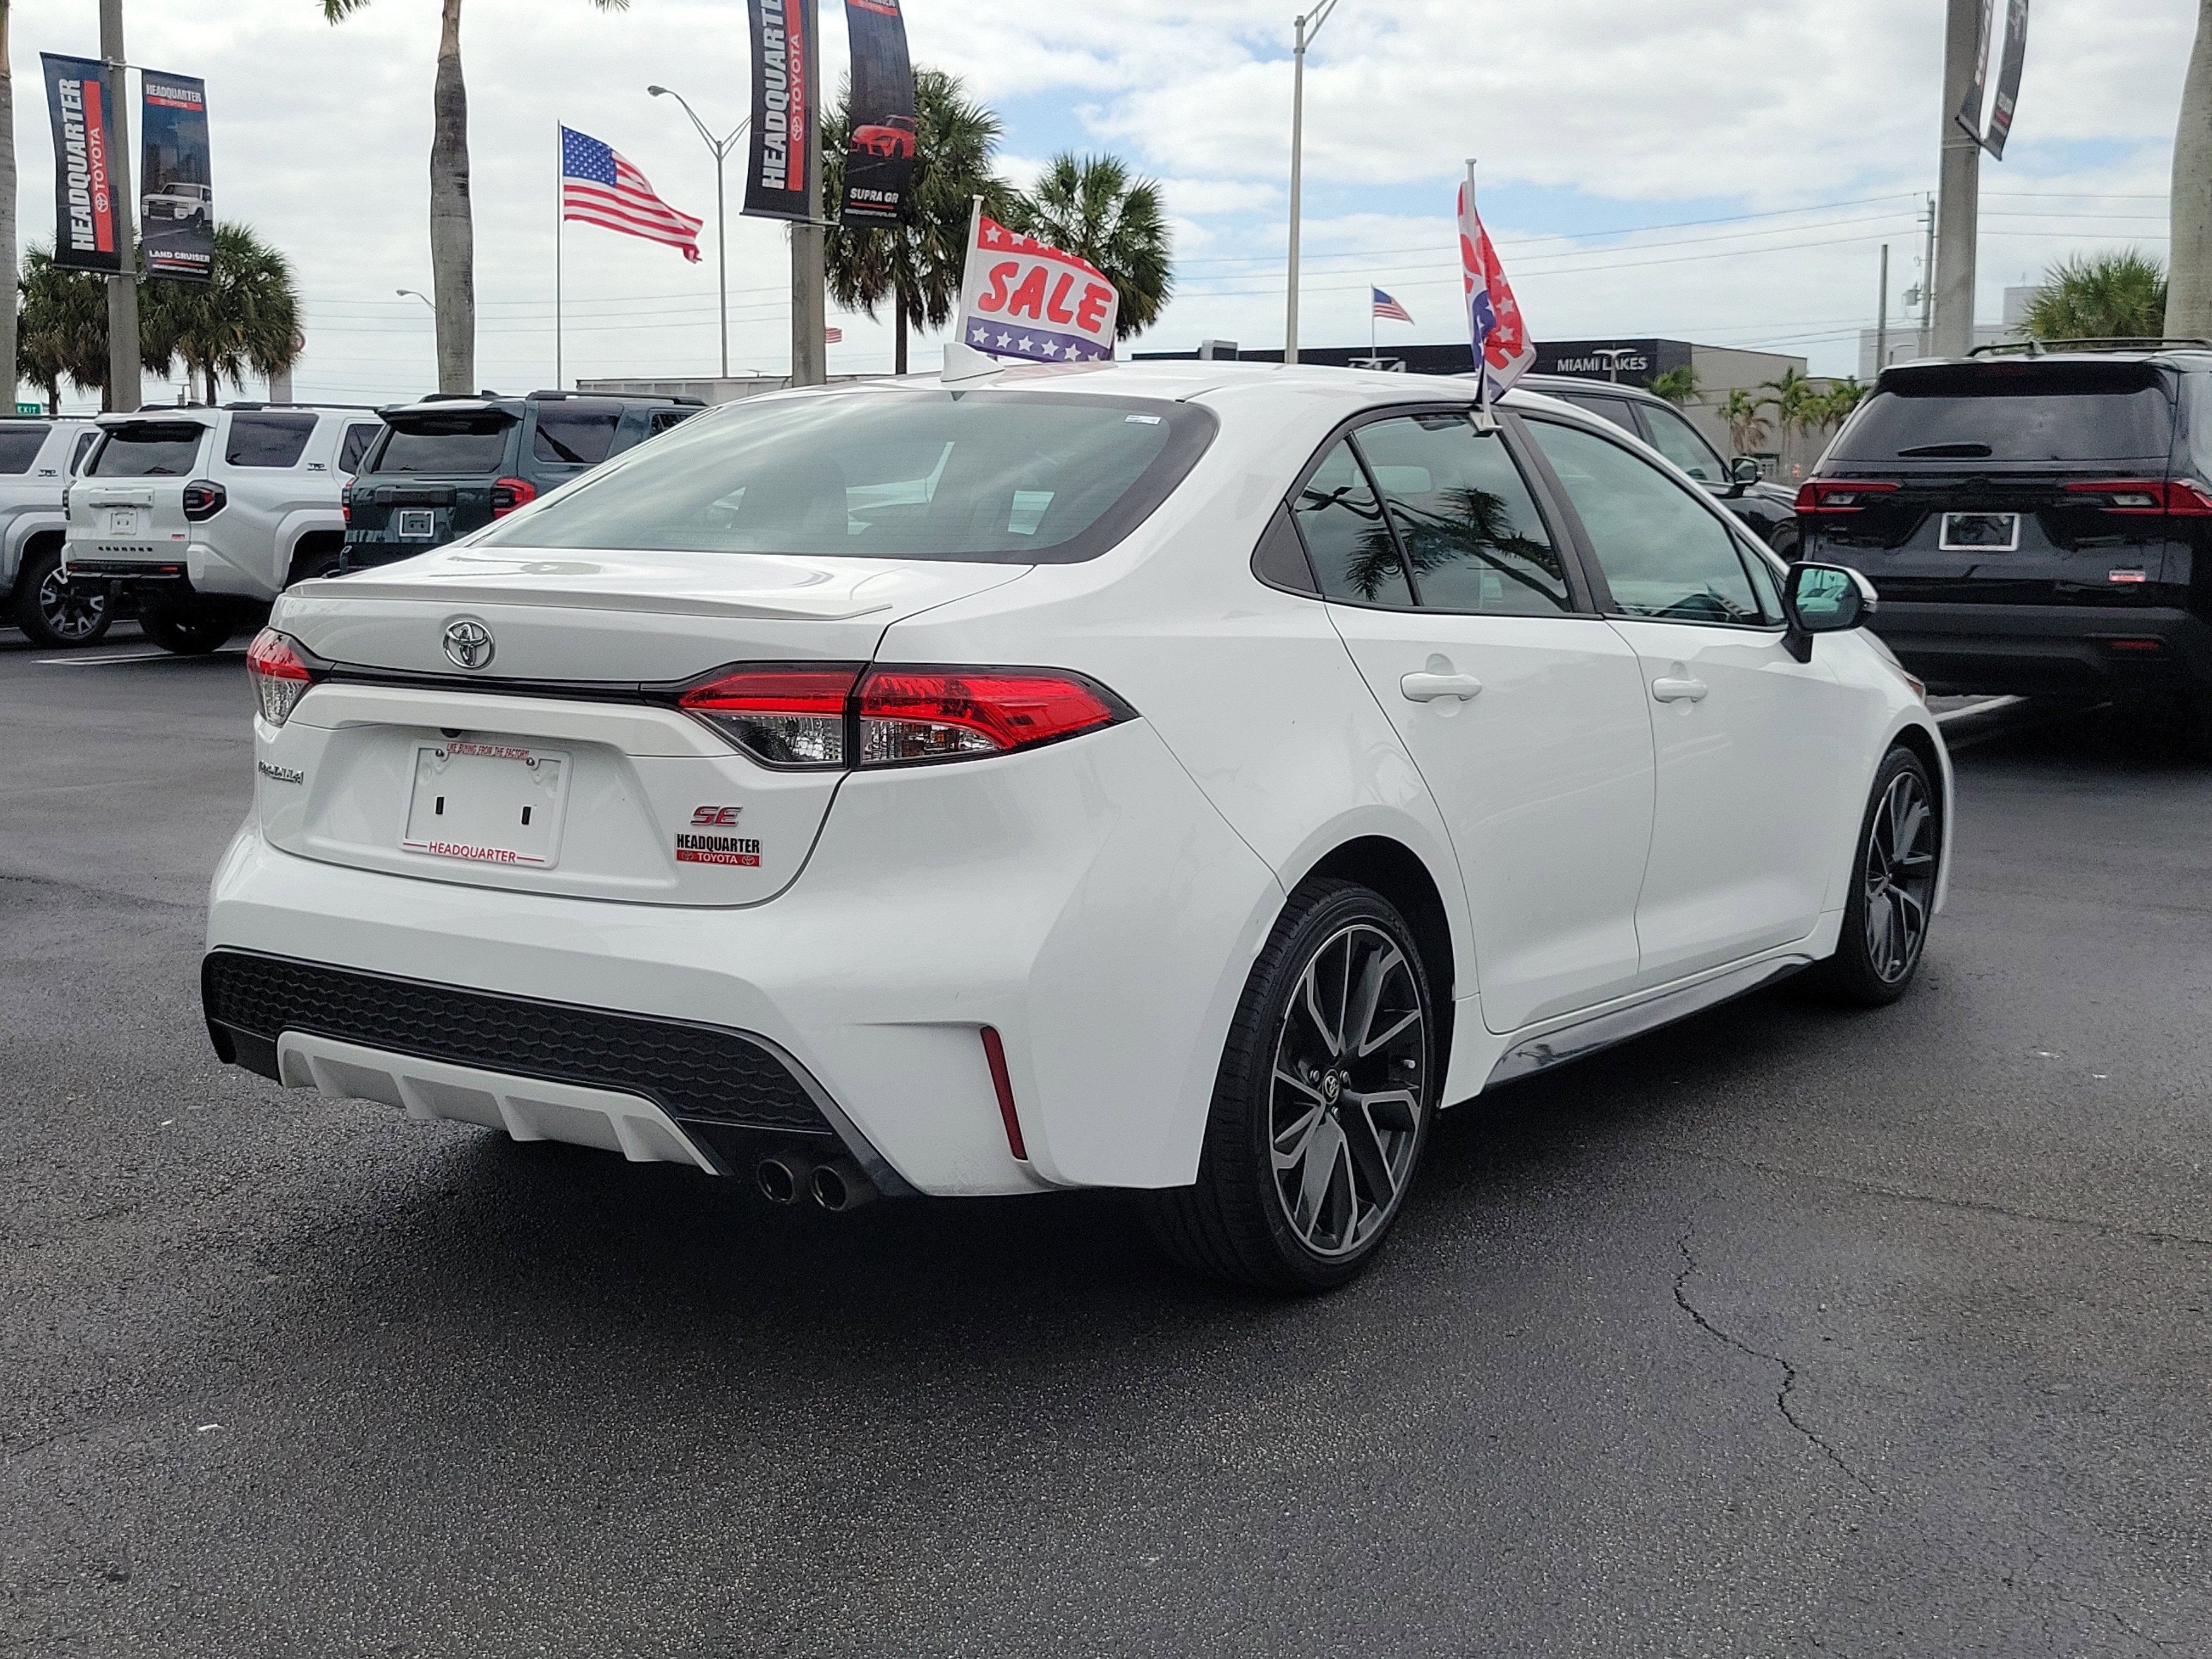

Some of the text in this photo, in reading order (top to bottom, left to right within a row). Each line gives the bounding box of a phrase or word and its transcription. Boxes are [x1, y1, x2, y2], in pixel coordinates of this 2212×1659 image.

[790, 34, 803, 113] TOYOTA
[146, 84, 202, 103] HEADQUARTER
[59, 78, 95, 251] HEADQUARTER
[90, 127, 104, 191] TOYOTA
[849, 188, 899, 203] SUPRA GR
[149, 250, 210, 262] LAND CRUISER
[978, 261, 1113, 334] SALE
[1557, 358, 1599, 371] MIAMI
[16, 405, 37, 414] EXIT
[690, 806, 743, 827] SE
[428, 842, 516, 862] HEADQUARTER
[676, 833, 760, 854] HEADQUARTER
[697, 853, 738, 864] TOYOTA
